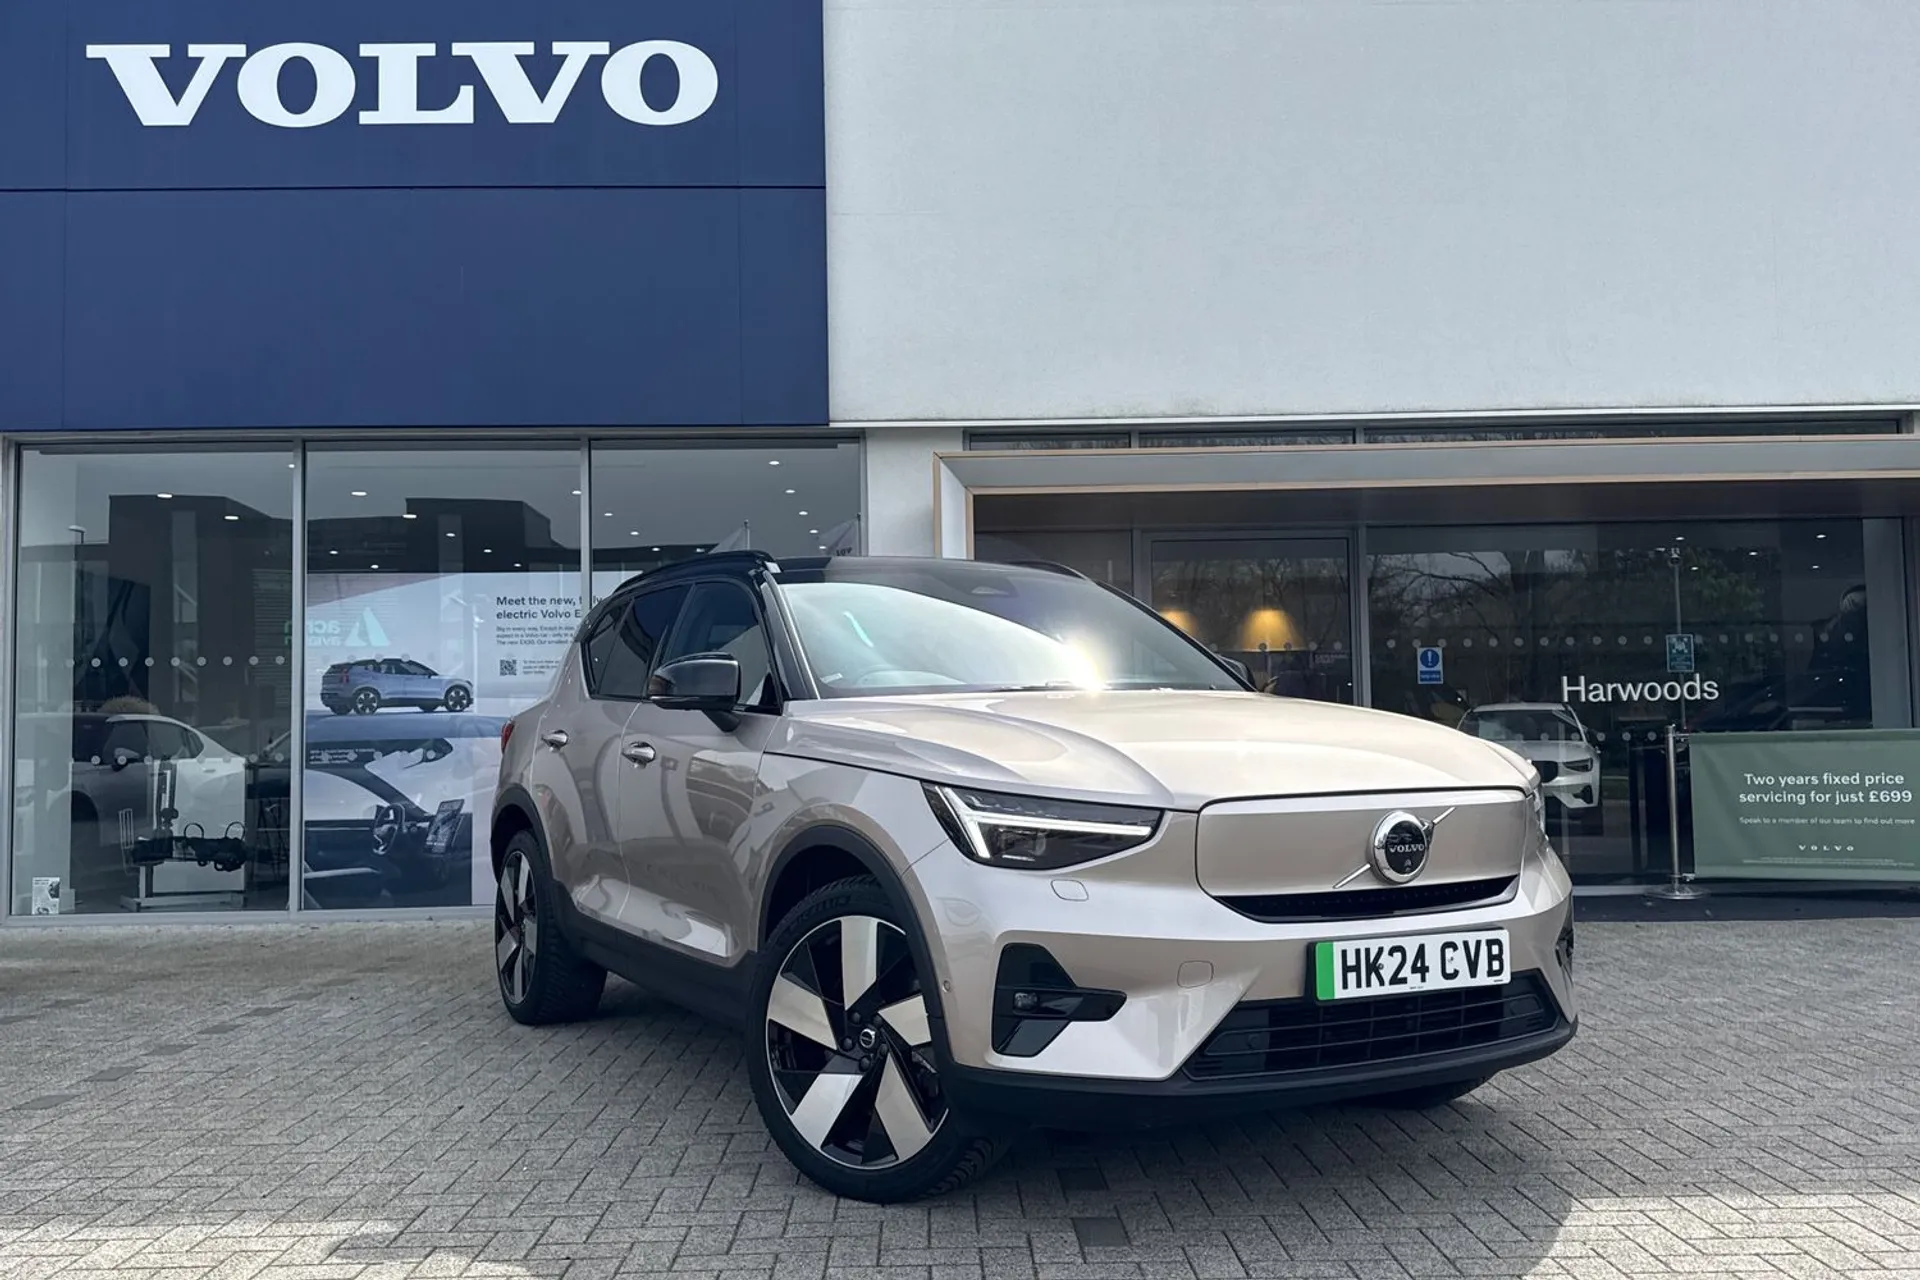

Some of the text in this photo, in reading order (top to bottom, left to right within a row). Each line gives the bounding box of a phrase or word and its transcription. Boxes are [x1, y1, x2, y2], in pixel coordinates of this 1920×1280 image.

[86, 40, 718, 128] VOLVO
[497, 596, 526, 606] Meet
[528, 596, 547, 606] the
[549, 597, 576, 607] new,
[496, 609, 538, 619] electric
[541, 609, 571, 619] Volvo
[1561, 673, 1719, 702] Harwoods
[1744, 772, 1905, 787] Two years fixed price
[1739, 790, 1913, 805] servicing for just £699
[1739, 817, 1761, 825] Speak
[1388, 843, 1425, 853] VOLVO
[1341, 938, 1504, 990] HK24 CVB
